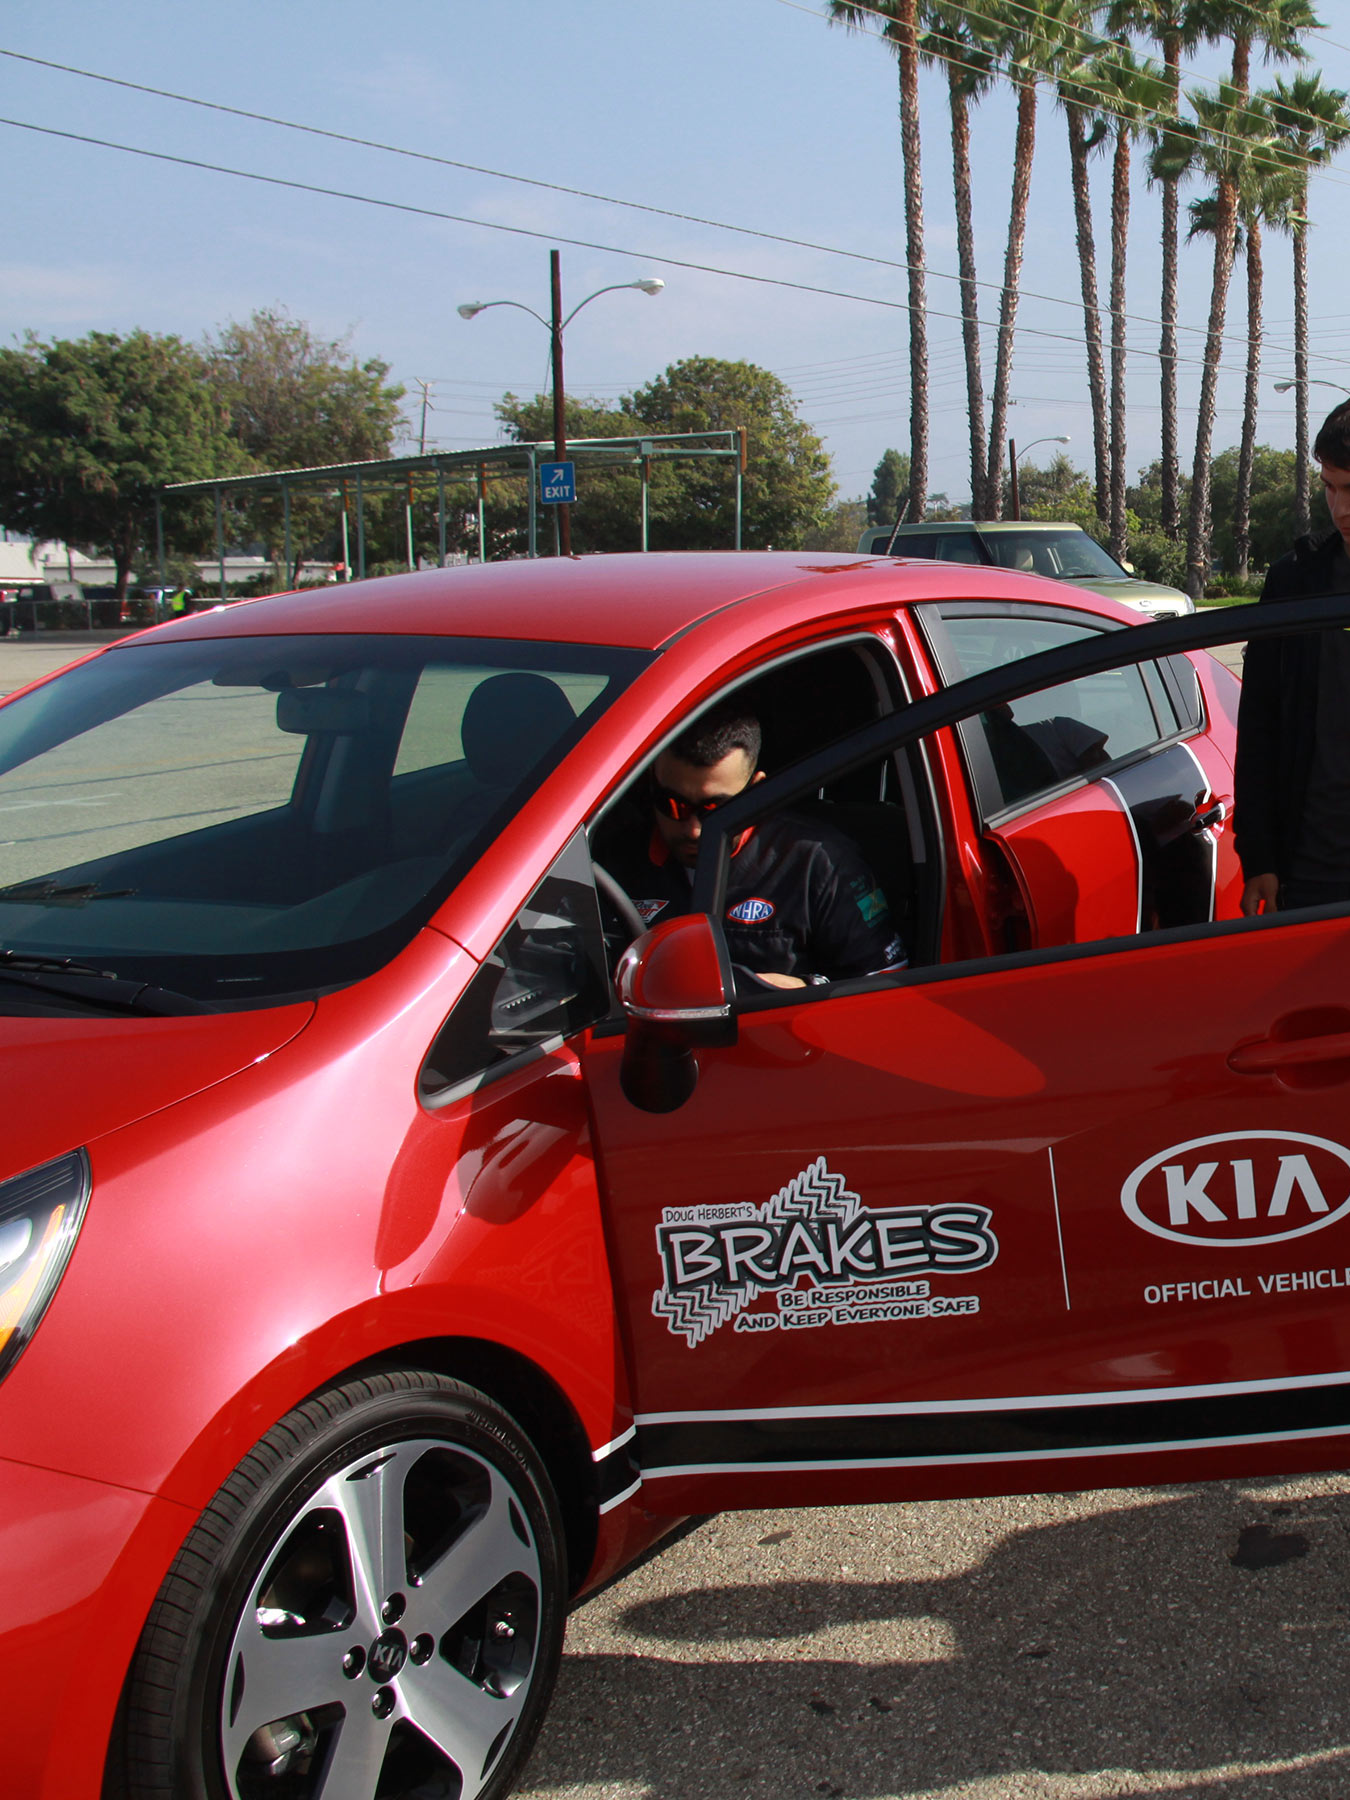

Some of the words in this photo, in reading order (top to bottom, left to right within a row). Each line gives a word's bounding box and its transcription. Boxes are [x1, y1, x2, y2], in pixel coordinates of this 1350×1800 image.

[544, 485, 571, 499] EXIT
[732, 902, 769, 919] NHRA
[1161, 1153, 1330, 1226] KIA
[665, 1209, 695, 1223] DOUG
[698, 1205, 754, 1221] HERBERT'S
[665, 1210, 991, 1287] BRAKES
[780, 1293, 804, 1308] BE
[811, 1283, 928, 1303] RESPONSIBLE
[1143, 1277, 1251, 1304] OFFICIAL
[737, 1313, 776, 1331] AND
[783, 1311, 829, 1327] KEEP
[836, 1303, 926, 1323] EVERYONE
[930, 1299, 977, 1315] SAFE
[373, 1644, 403, 1667] KIA
